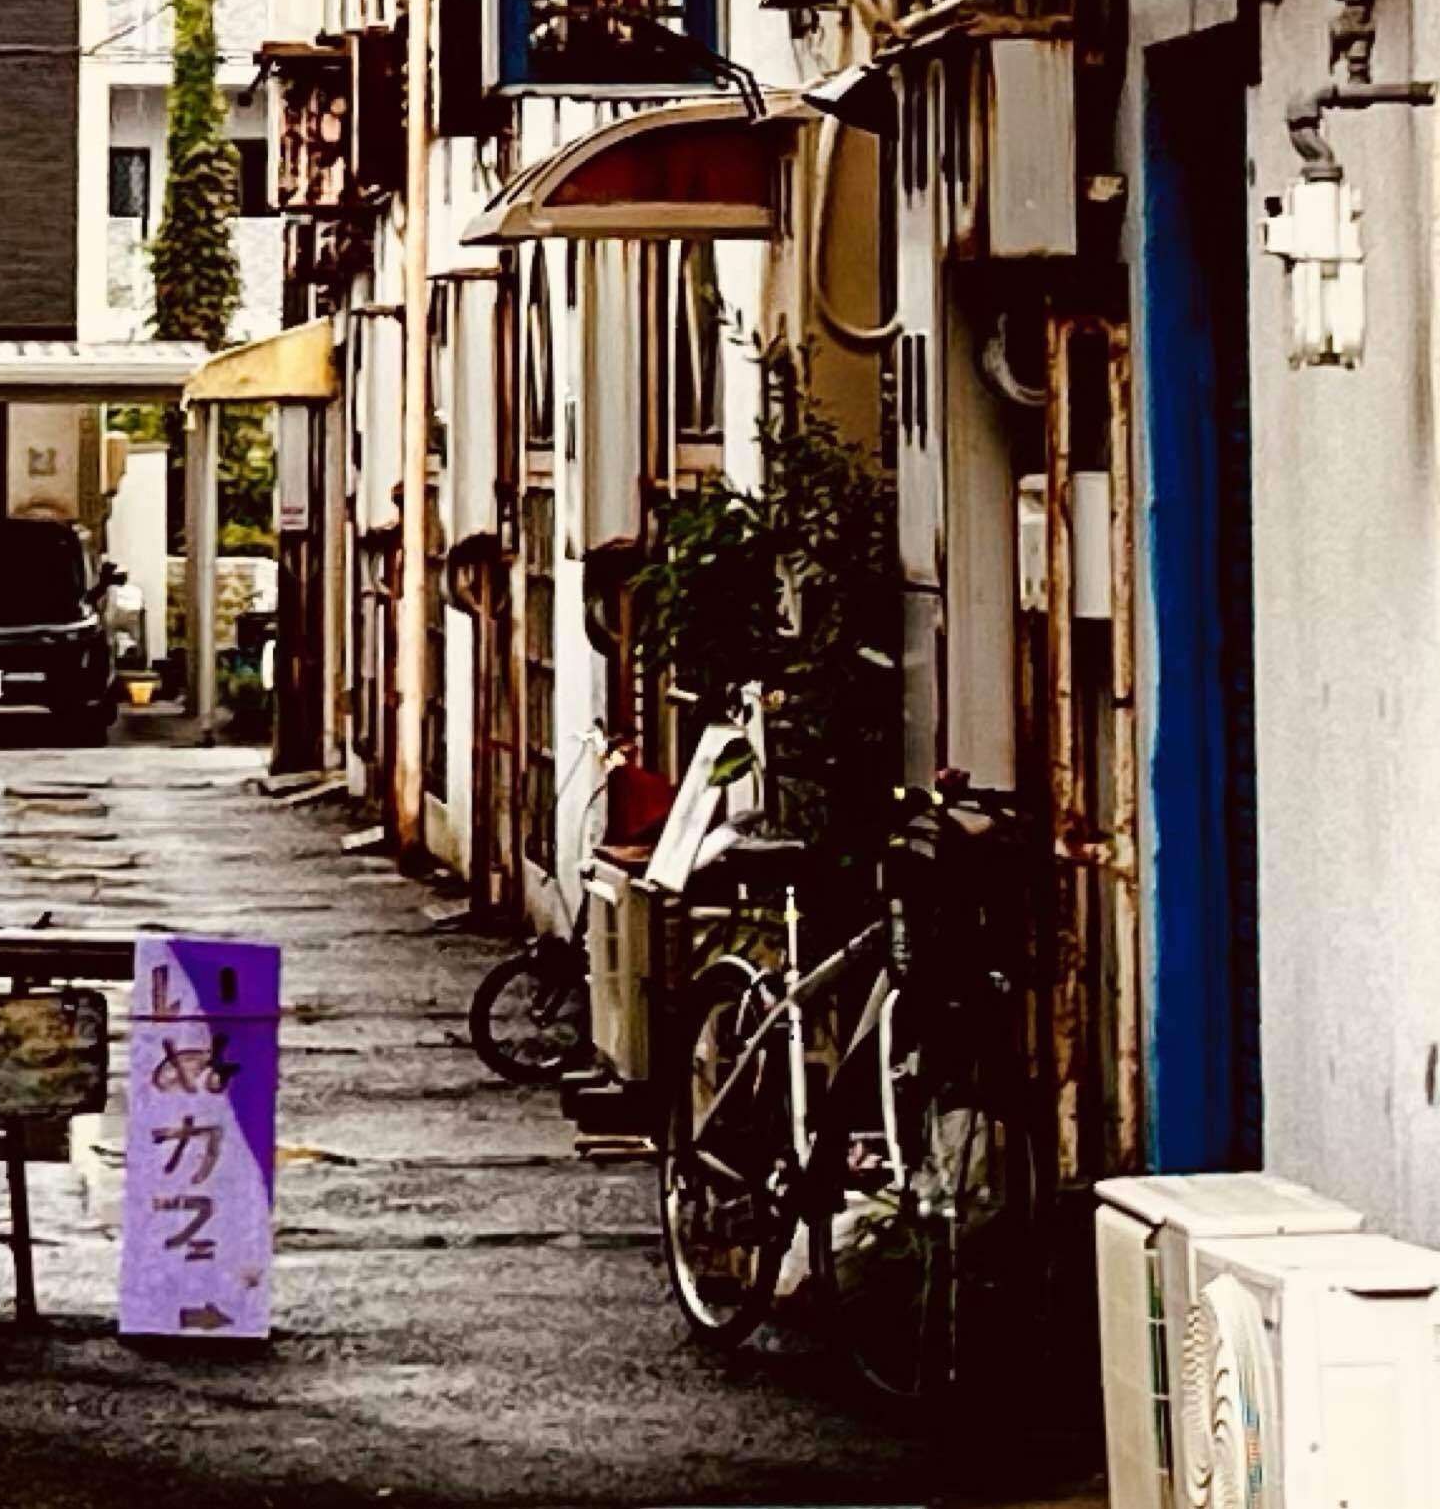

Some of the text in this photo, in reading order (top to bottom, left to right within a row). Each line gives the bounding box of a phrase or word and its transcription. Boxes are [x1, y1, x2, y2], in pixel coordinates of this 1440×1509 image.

[151, 964, 241, 1262] いぬカフェ
